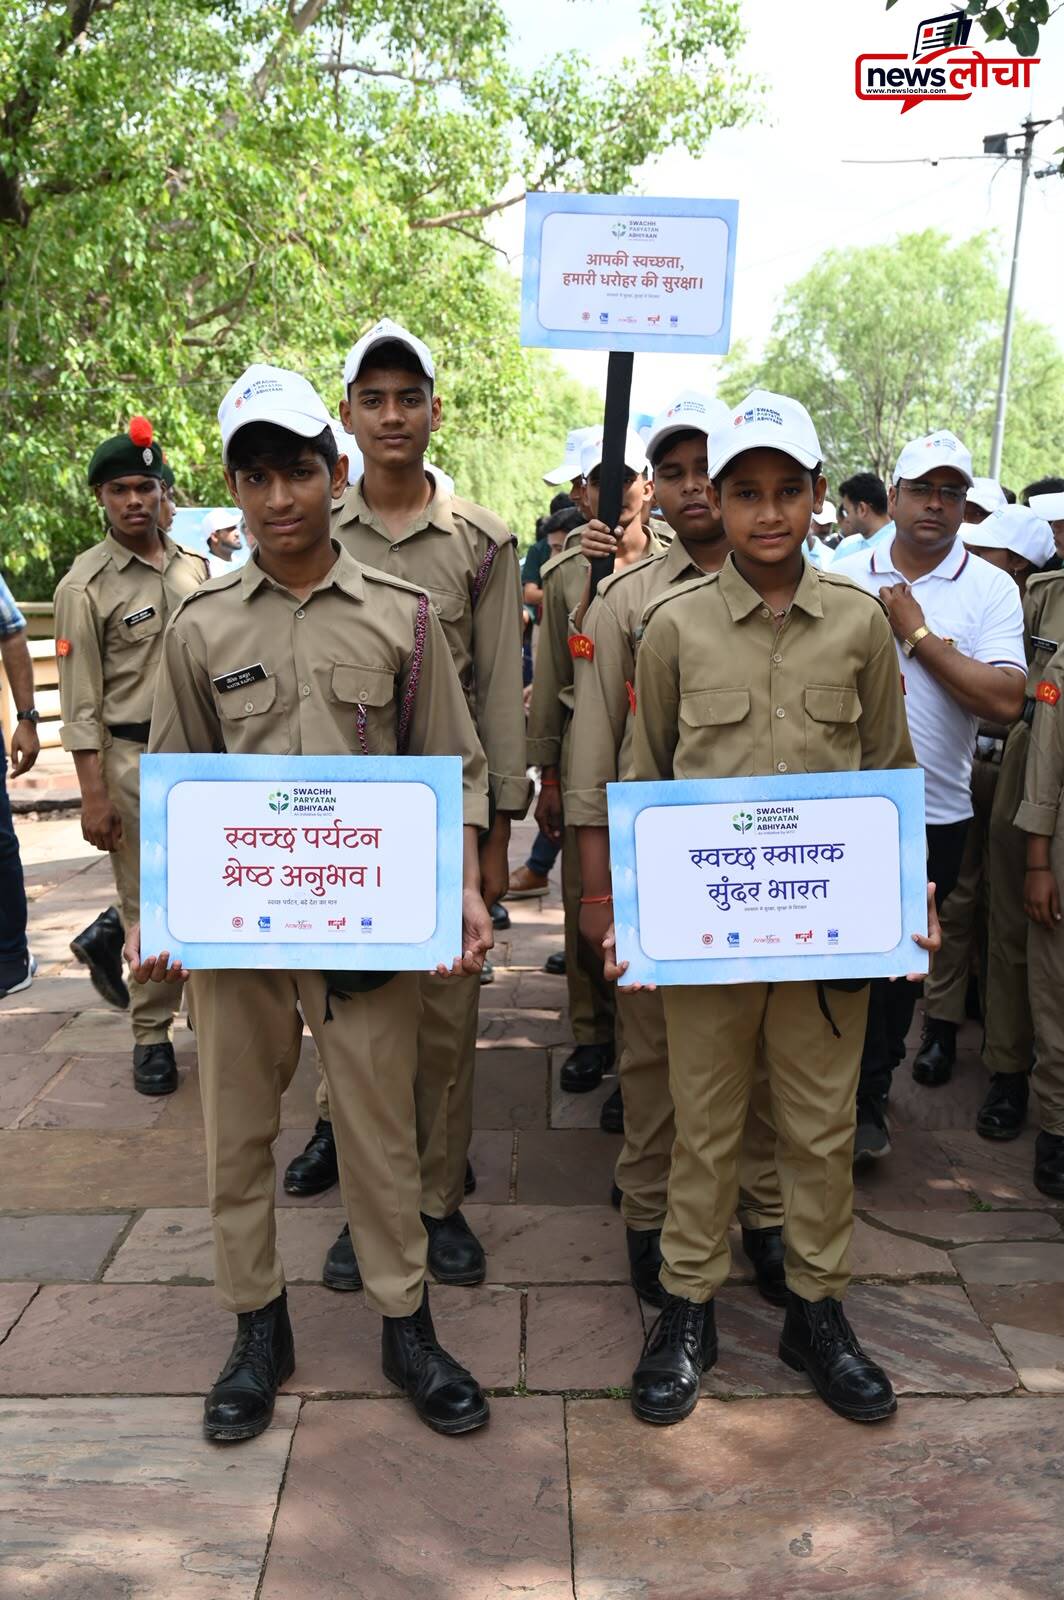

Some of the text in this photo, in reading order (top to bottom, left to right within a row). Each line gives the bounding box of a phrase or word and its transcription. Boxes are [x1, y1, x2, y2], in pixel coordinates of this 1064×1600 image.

[586, 251, 685, 271] आपकी स्वच्छता,
[562, 270, 597, 286] हमारी
[600, 271, 637, 288] धरोहर
[640, 271, 659, 289] की
[293, 788, 332, 796] SWACHH
[293, 796, 337, 804] PARYATAN
[293, 804, 335, 812] ABHIYAAN
[756, 807, 795, 815] SWACHH
[757, 815, 800, 823] PARYATAN
[756, 823, 798, 831] ABHIYAAN
[223, 819, 383, 853] स्वच्छ पर्यटन
[688, 842, 846, 870] स्वच्छ स्मारक
[221, 857, 275, 888] श्रेष्ठ
[279, 864, 368, 897] अनुभव
[706, 875, 831, 911] सुंदर भारत
